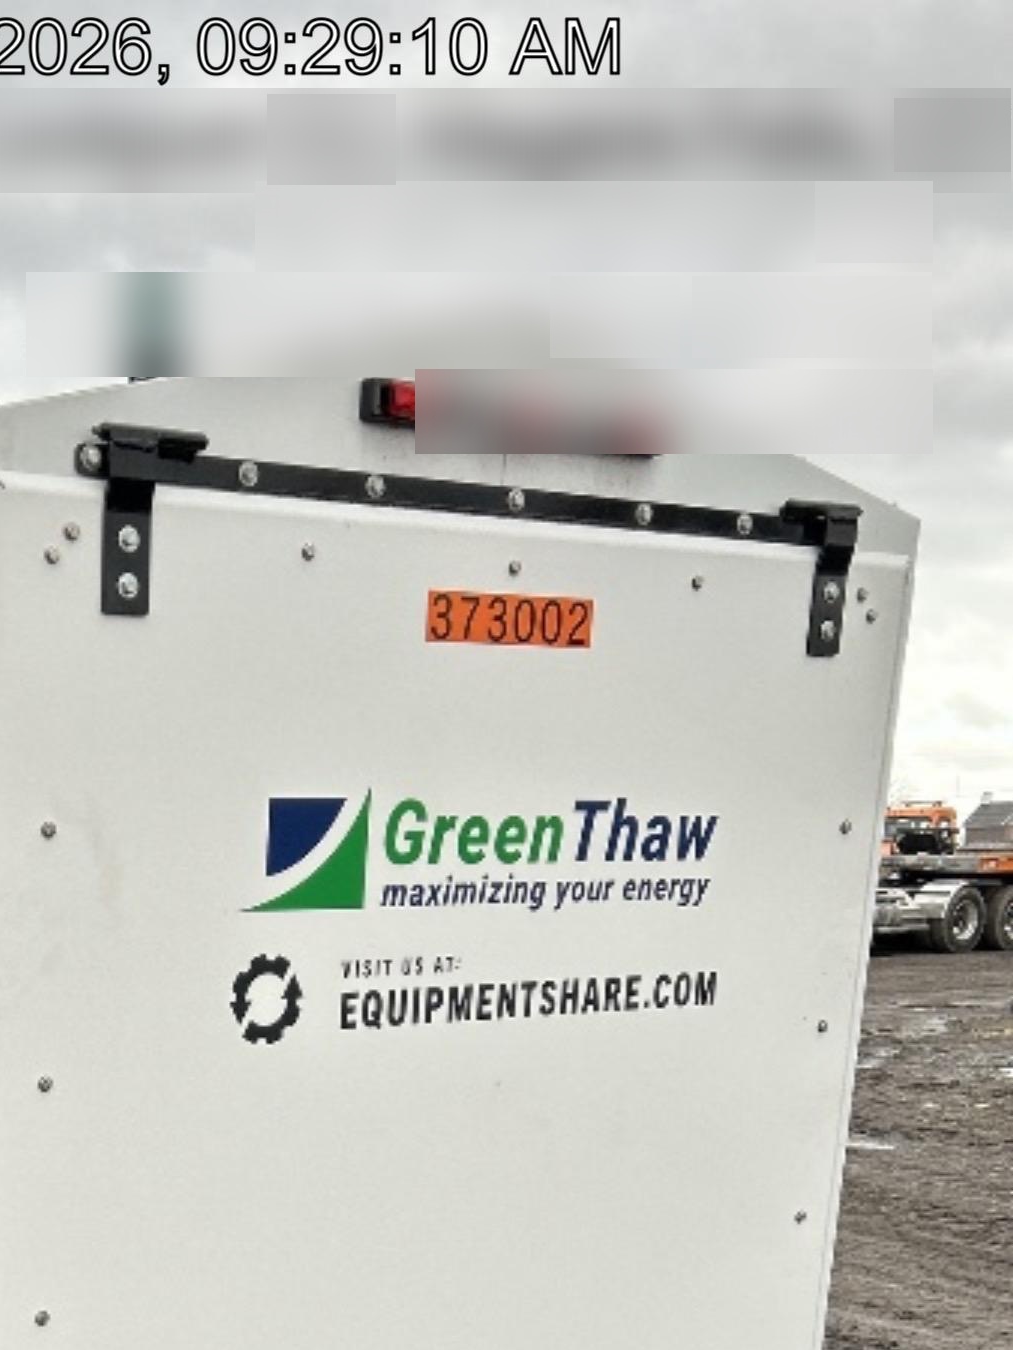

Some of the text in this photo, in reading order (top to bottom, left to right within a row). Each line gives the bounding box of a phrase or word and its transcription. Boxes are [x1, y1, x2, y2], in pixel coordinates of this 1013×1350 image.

[431, 594, 589, 645] 373002
[380, 875, 710, 911] maximizing your energy
[341, 959, 392, 979] VISIT
[401, 957, 424, 975] US
[340, 971, 718, 1030] EQUIPMENTSHARE.COM
